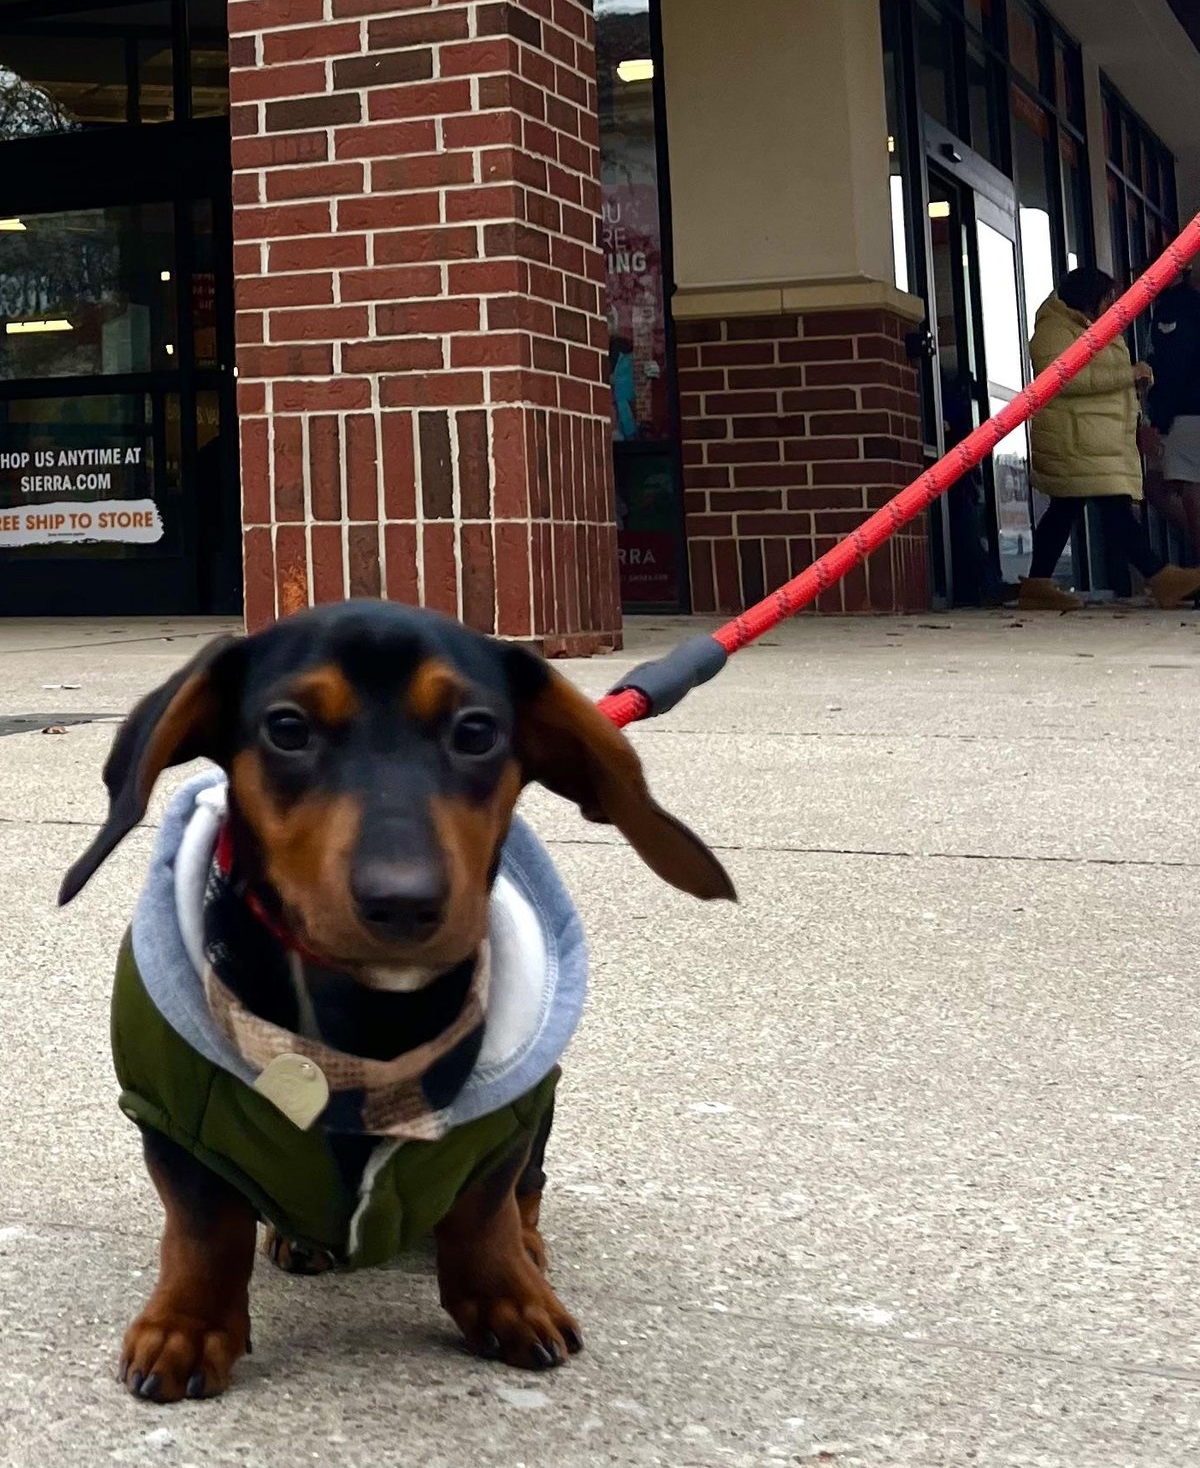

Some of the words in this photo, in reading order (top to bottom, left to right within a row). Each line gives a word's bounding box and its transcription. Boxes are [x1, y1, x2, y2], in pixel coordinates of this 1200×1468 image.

[35, 450, 55, 467] US
[57, 448, 121, 467] ANYTIME
[124, 446, 142, 465] AT
[20, 473, 112, 492] SIERRA.COM
[26, 513, 65, 530] SHIP
[69, 512, 92, 529] TO
[98, 510, 154, 529] STORE
